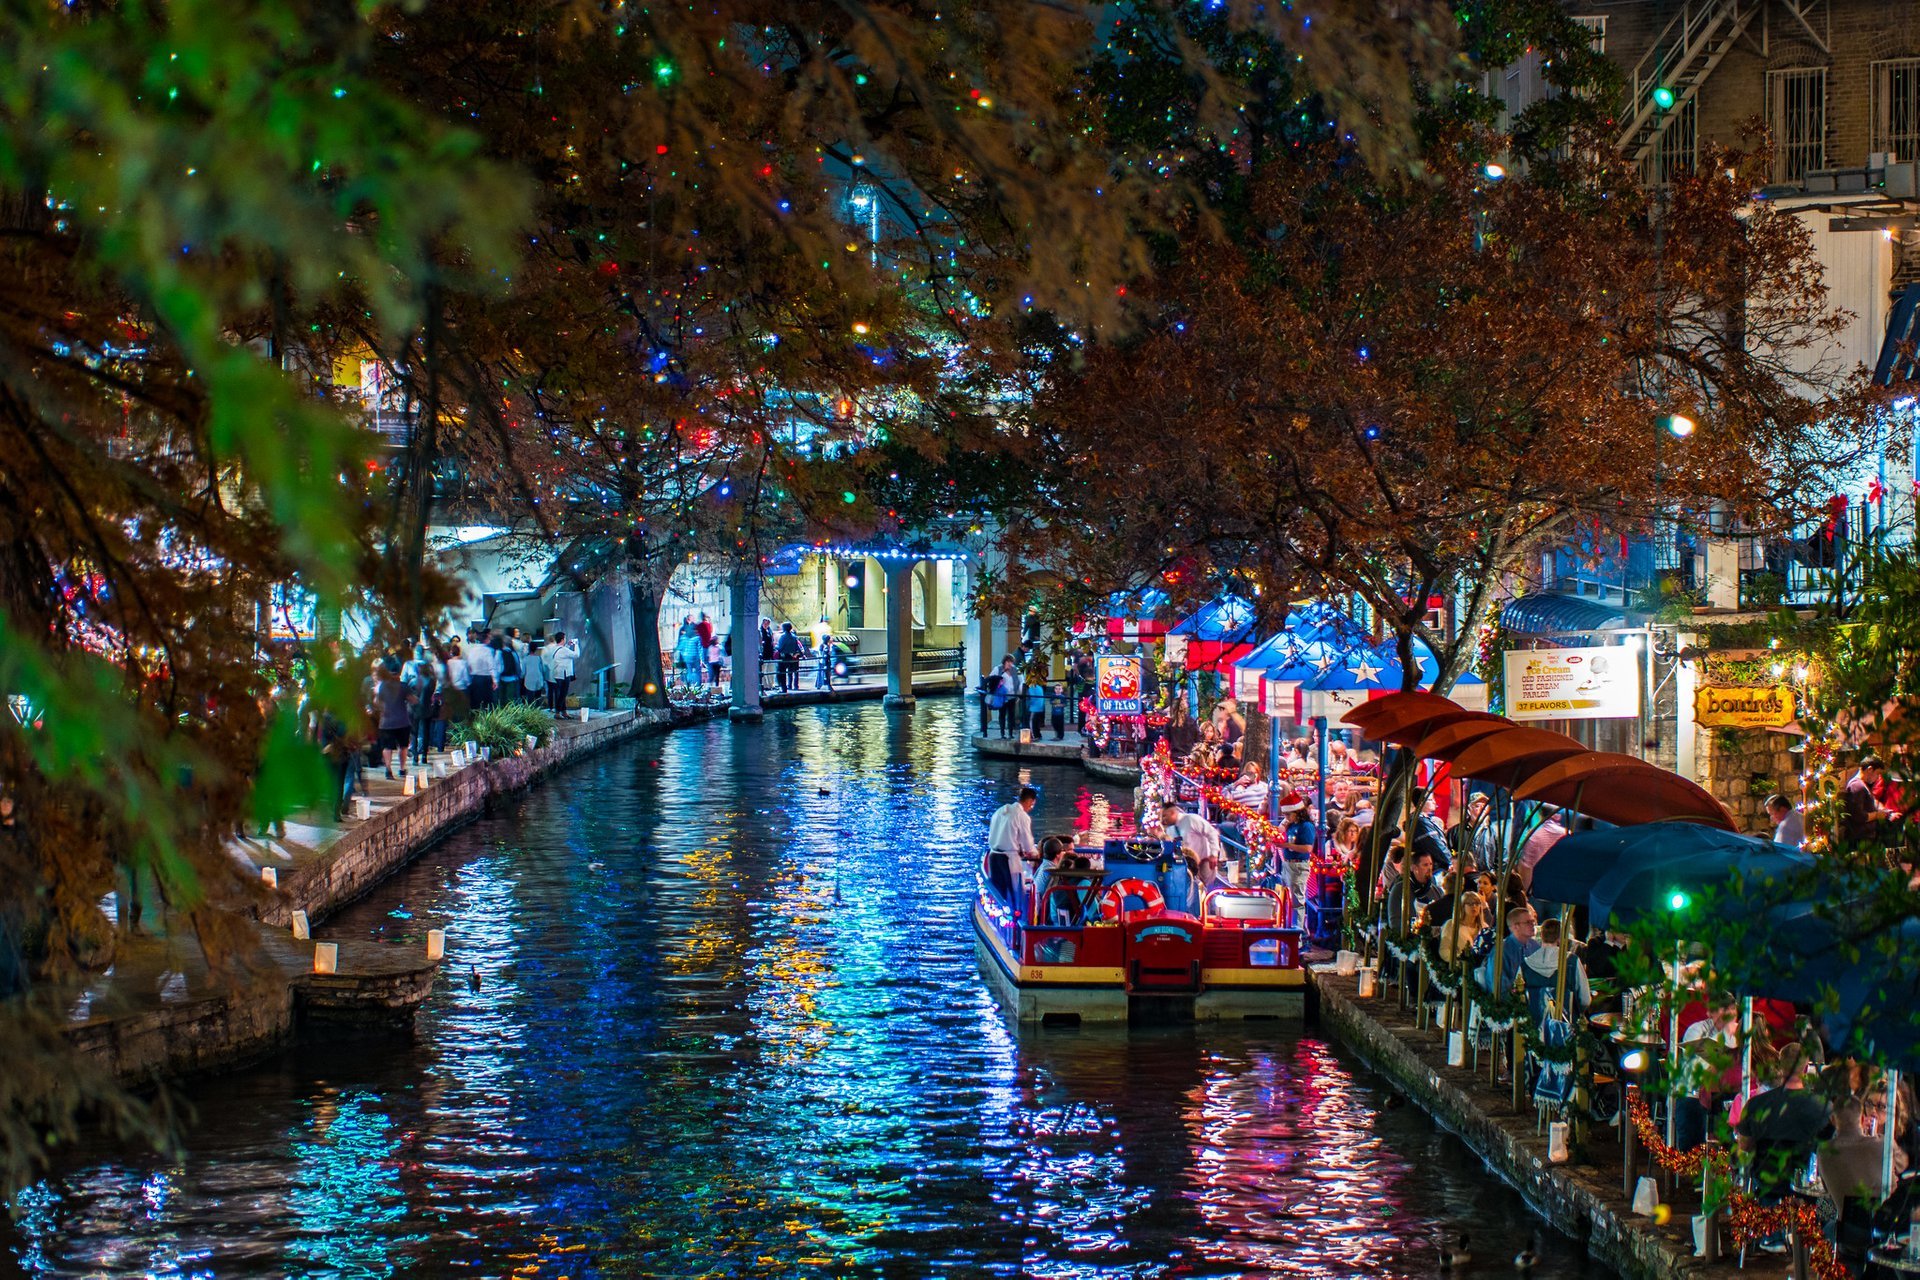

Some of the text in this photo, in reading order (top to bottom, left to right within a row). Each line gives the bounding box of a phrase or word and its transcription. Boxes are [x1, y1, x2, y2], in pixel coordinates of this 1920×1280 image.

[1542, 666, 1571, 675] Cream
[1102, 668, 1136, 686] REPUBLIC
[1536, 674, 1574, 682] FASHIONED
[1522, 682, 1560, 691] ICE CREAM
[1103, 700, 1136, 710] OF TEXAS
[1529, 701, 1567, 710] FLAVORS
